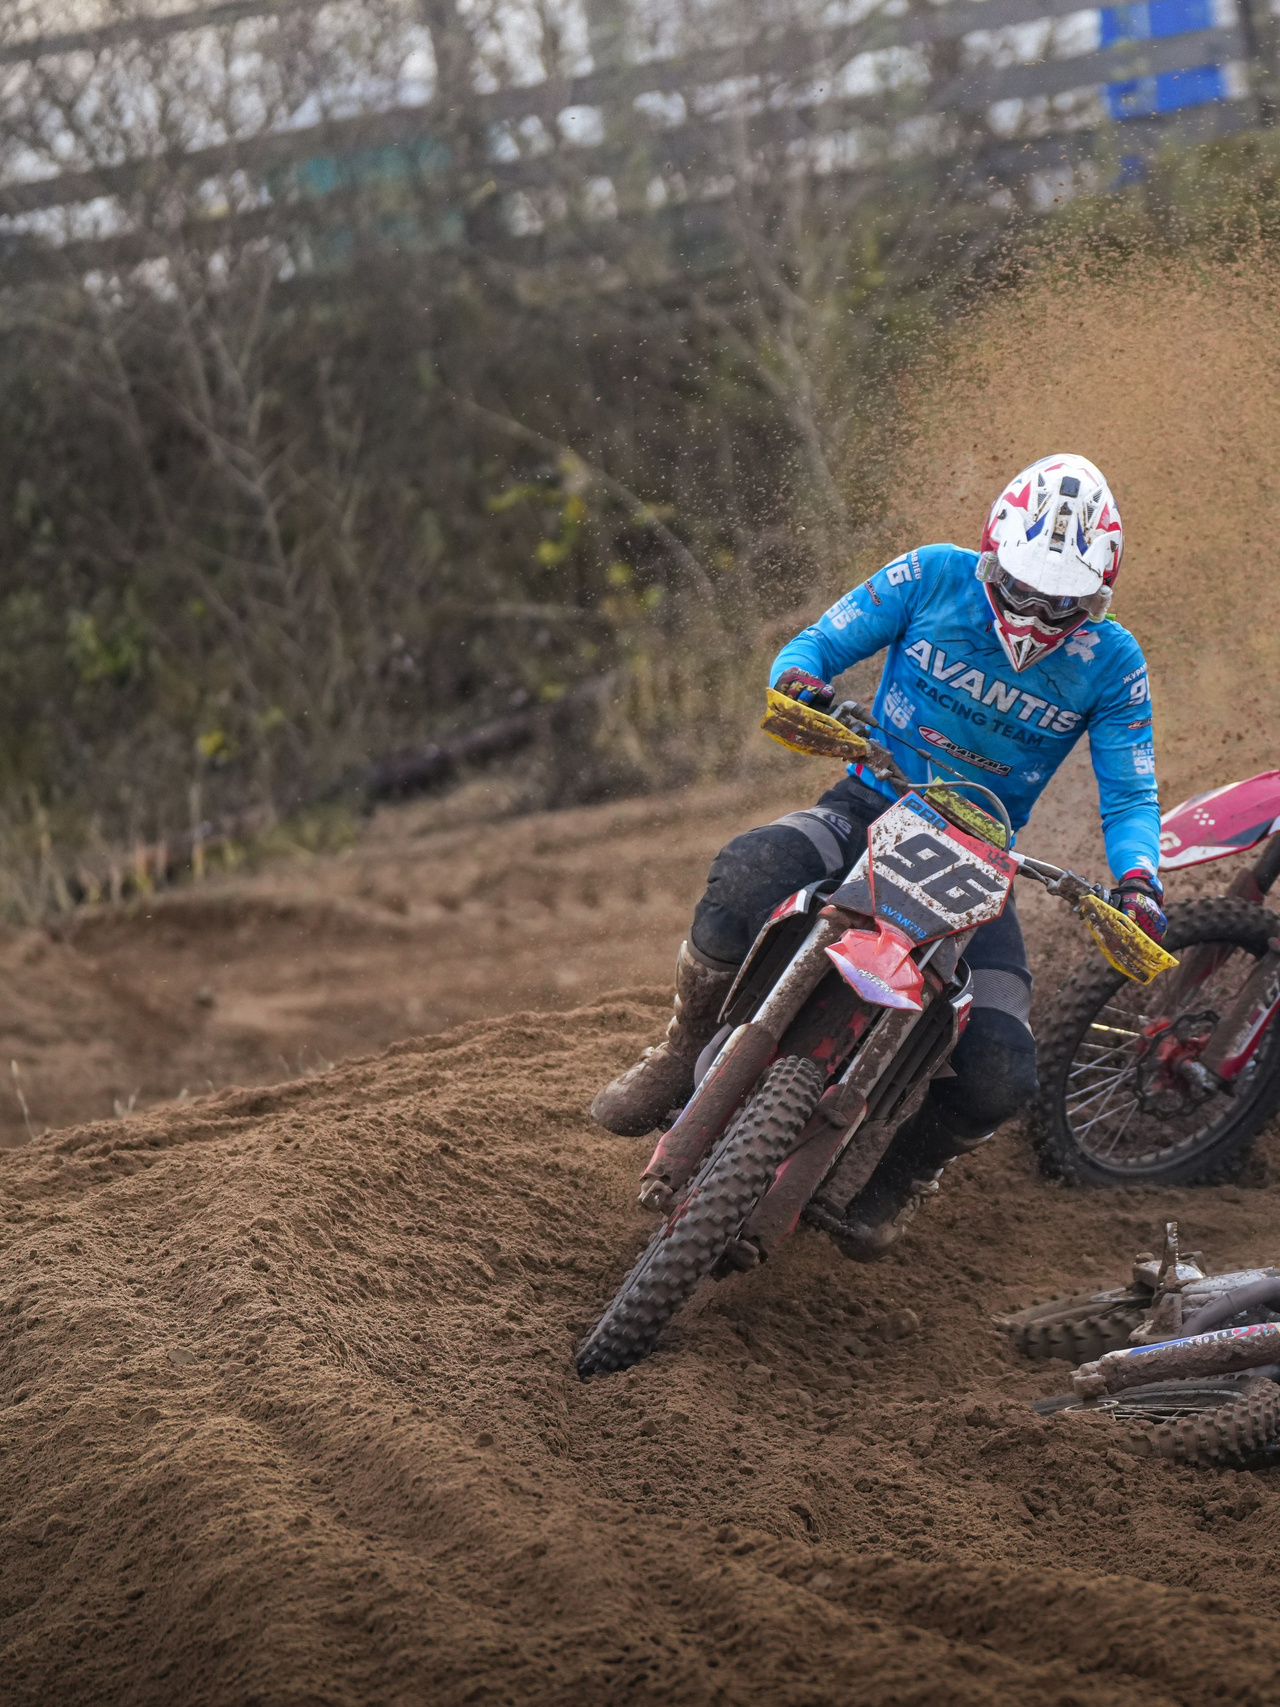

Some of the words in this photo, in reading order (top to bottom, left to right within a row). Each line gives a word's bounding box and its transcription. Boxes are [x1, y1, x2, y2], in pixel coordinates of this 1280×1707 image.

[905, 638, 1083, 733] AVANTIS
[916, 677, 986, 726] RACING
[989, 718, 1044, 748] TEAM
[903, 798, 949, 832] PRO
[873, 833, 1007, 914] 96
